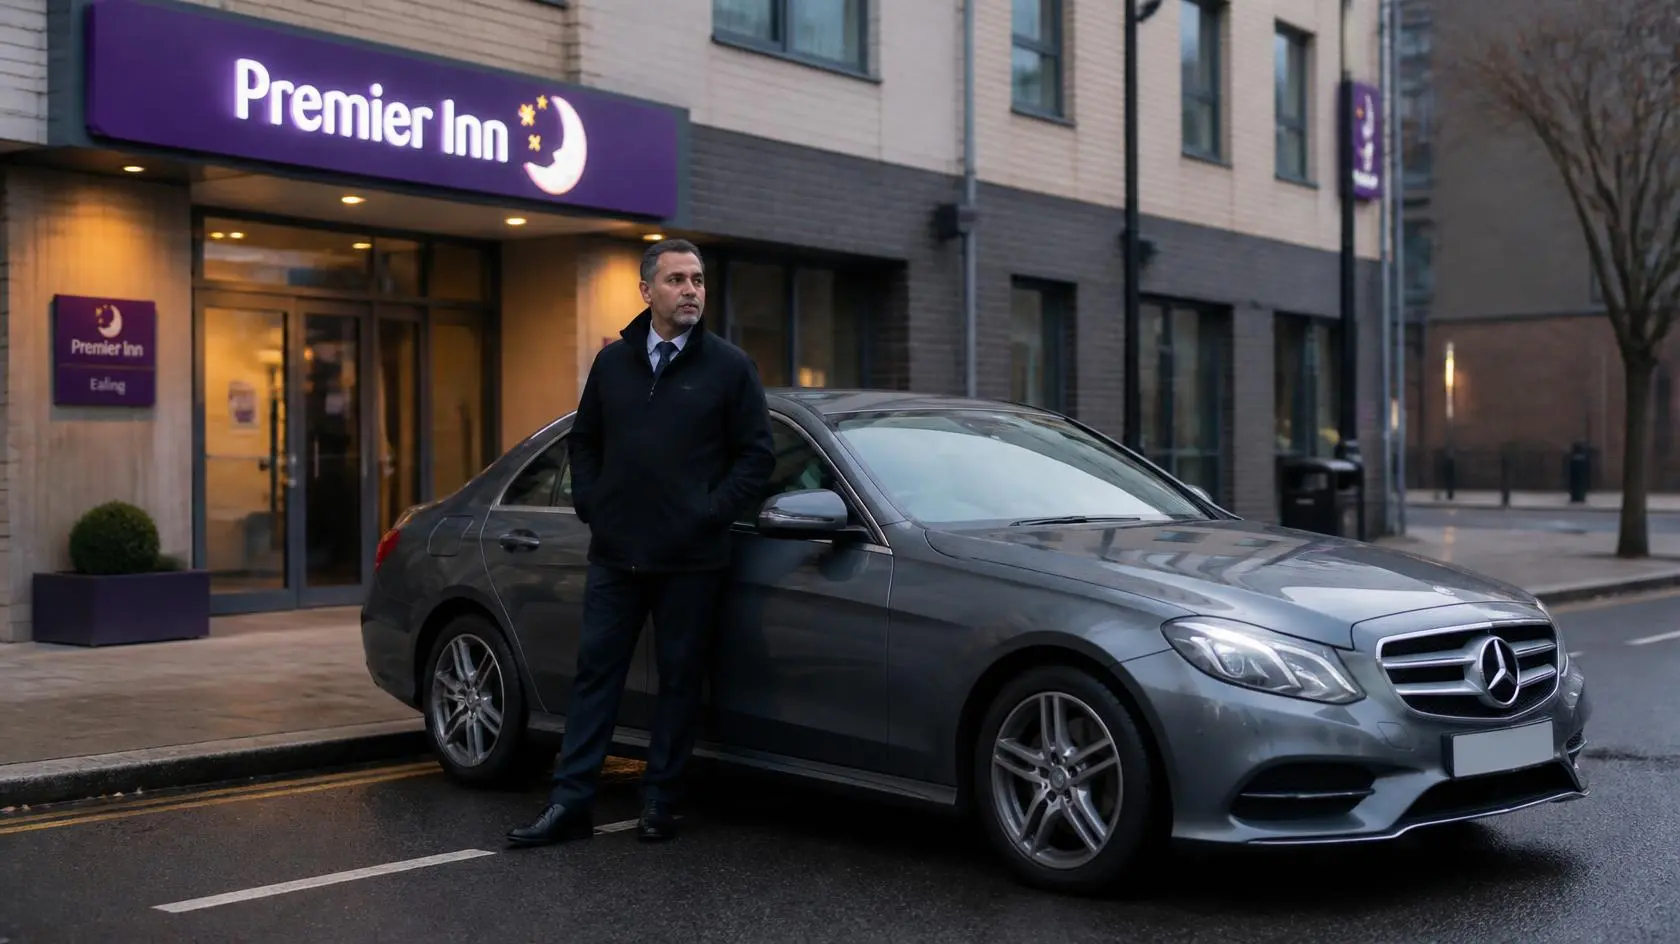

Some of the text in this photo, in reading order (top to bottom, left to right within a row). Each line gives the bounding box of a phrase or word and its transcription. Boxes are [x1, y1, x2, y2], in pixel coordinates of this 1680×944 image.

[234, 58, 509, 163] Premier Inn
[71, 339, 144, 357] Premier Inn
[90, 377, 126, 395] Ealing
